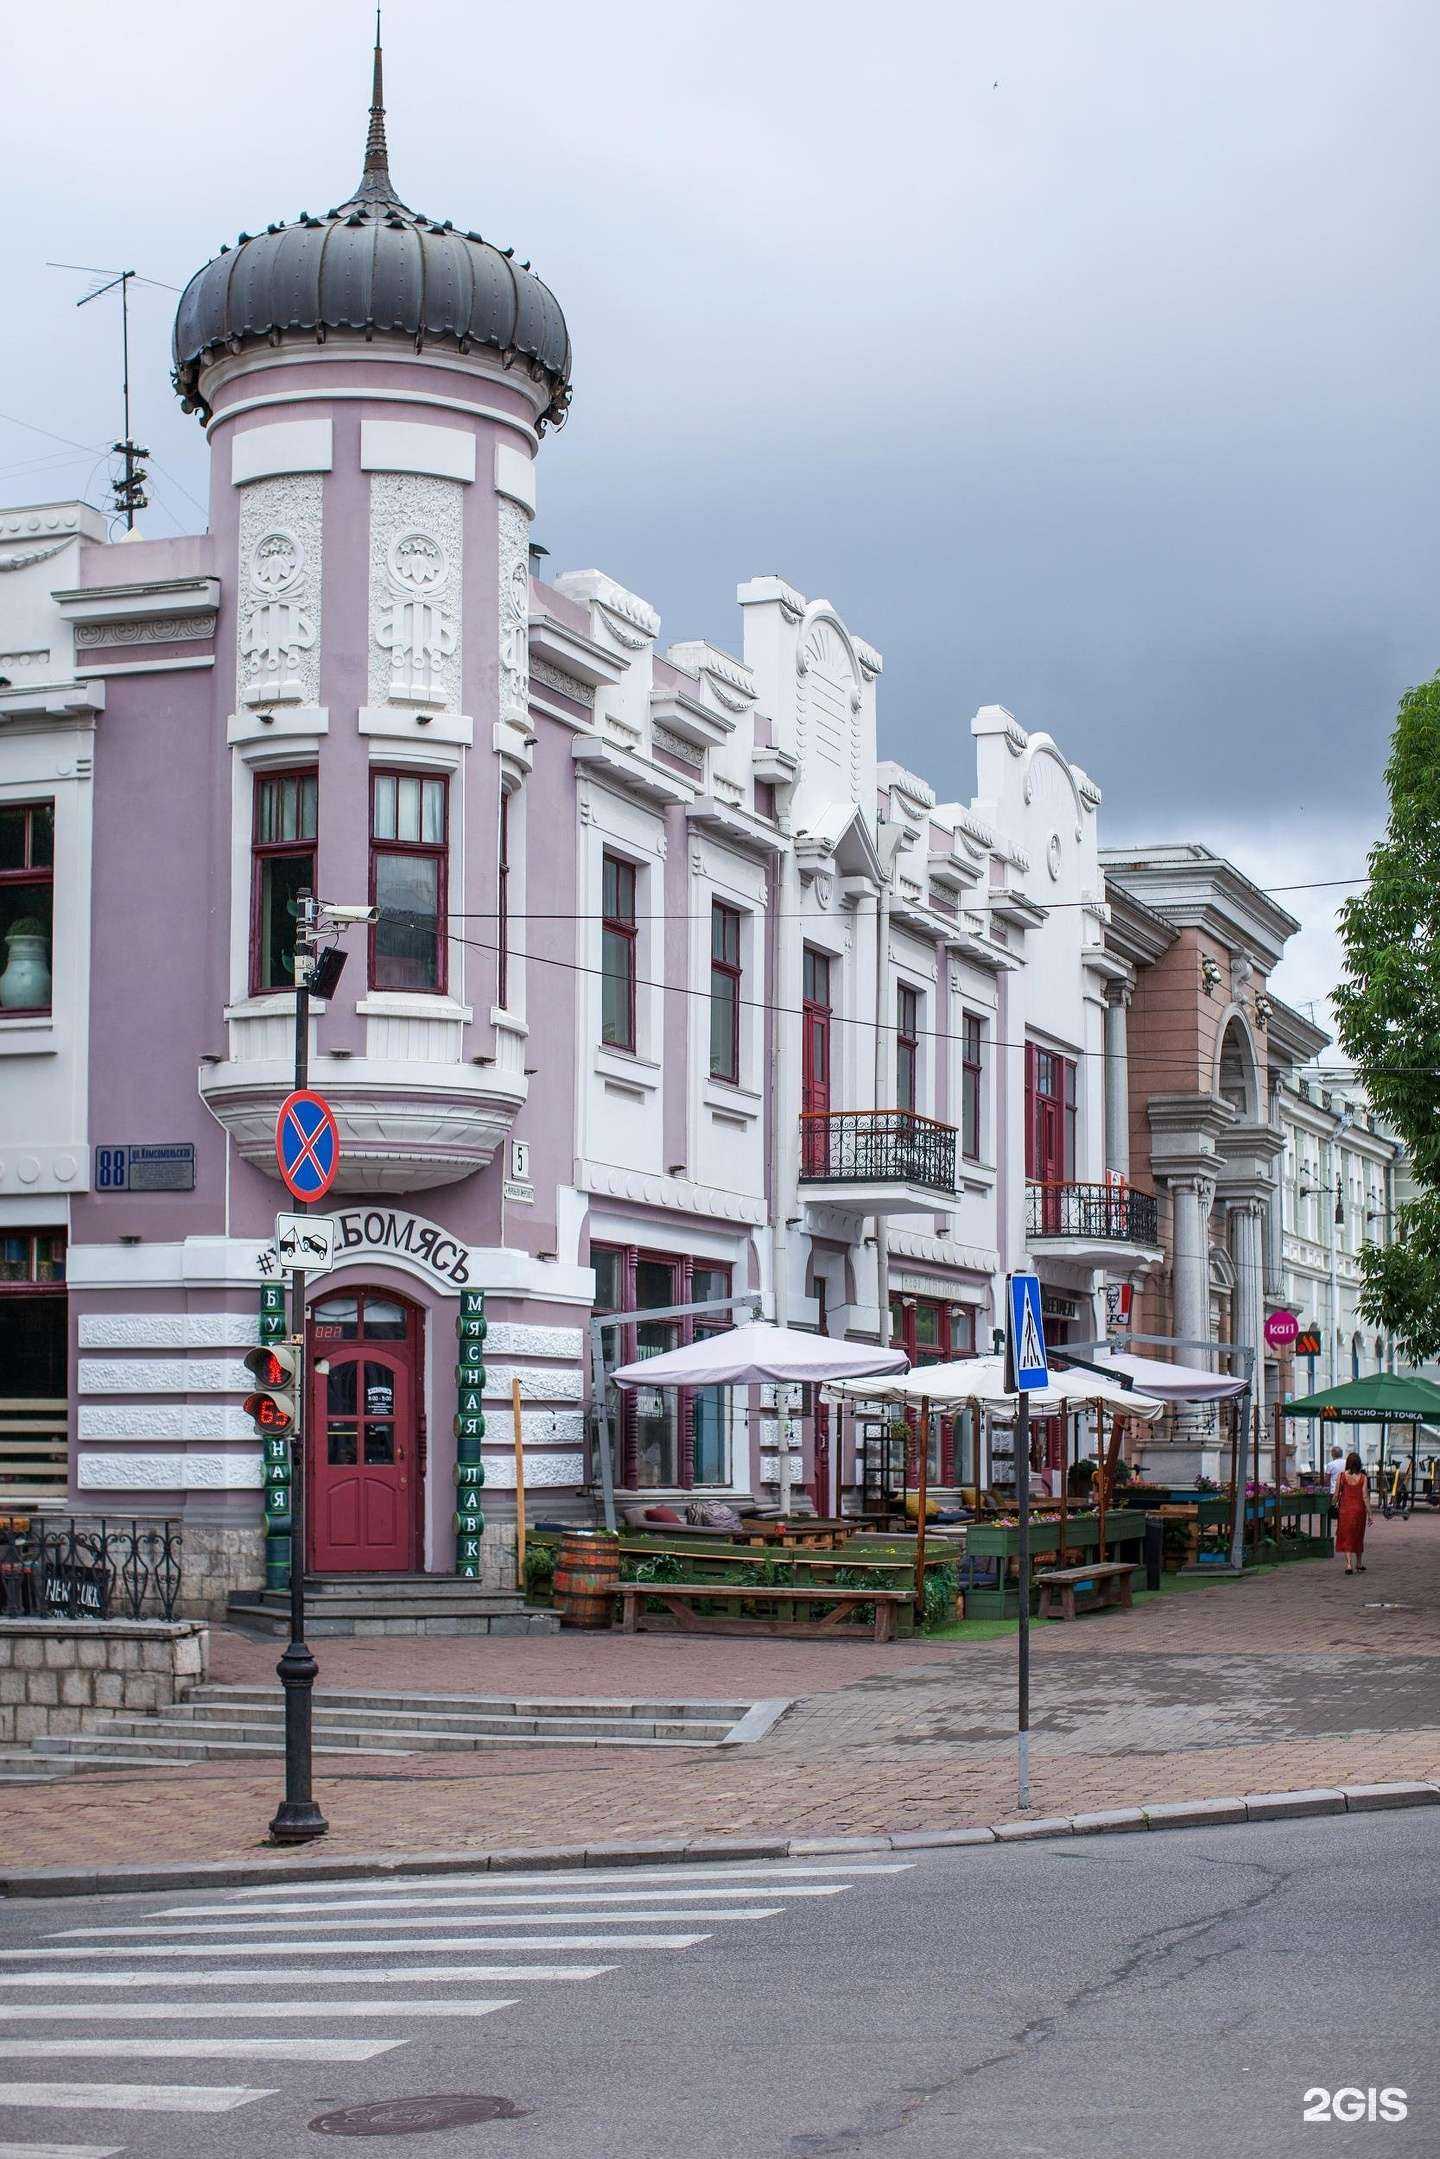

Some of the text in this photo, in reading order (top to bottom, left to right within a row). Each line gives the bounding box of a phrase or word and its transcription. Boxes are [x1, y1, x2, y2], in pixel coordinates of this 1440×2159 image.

[517, 1146, 523, 1172] 5
[100, 1151, 125, 1187] 88
[1269, 1323, 1295, 1335] kari
[1341, 1408, 1377, 1417] ВКУСНО
[1393, 1411, 1424, 1421] ТОЧКА
